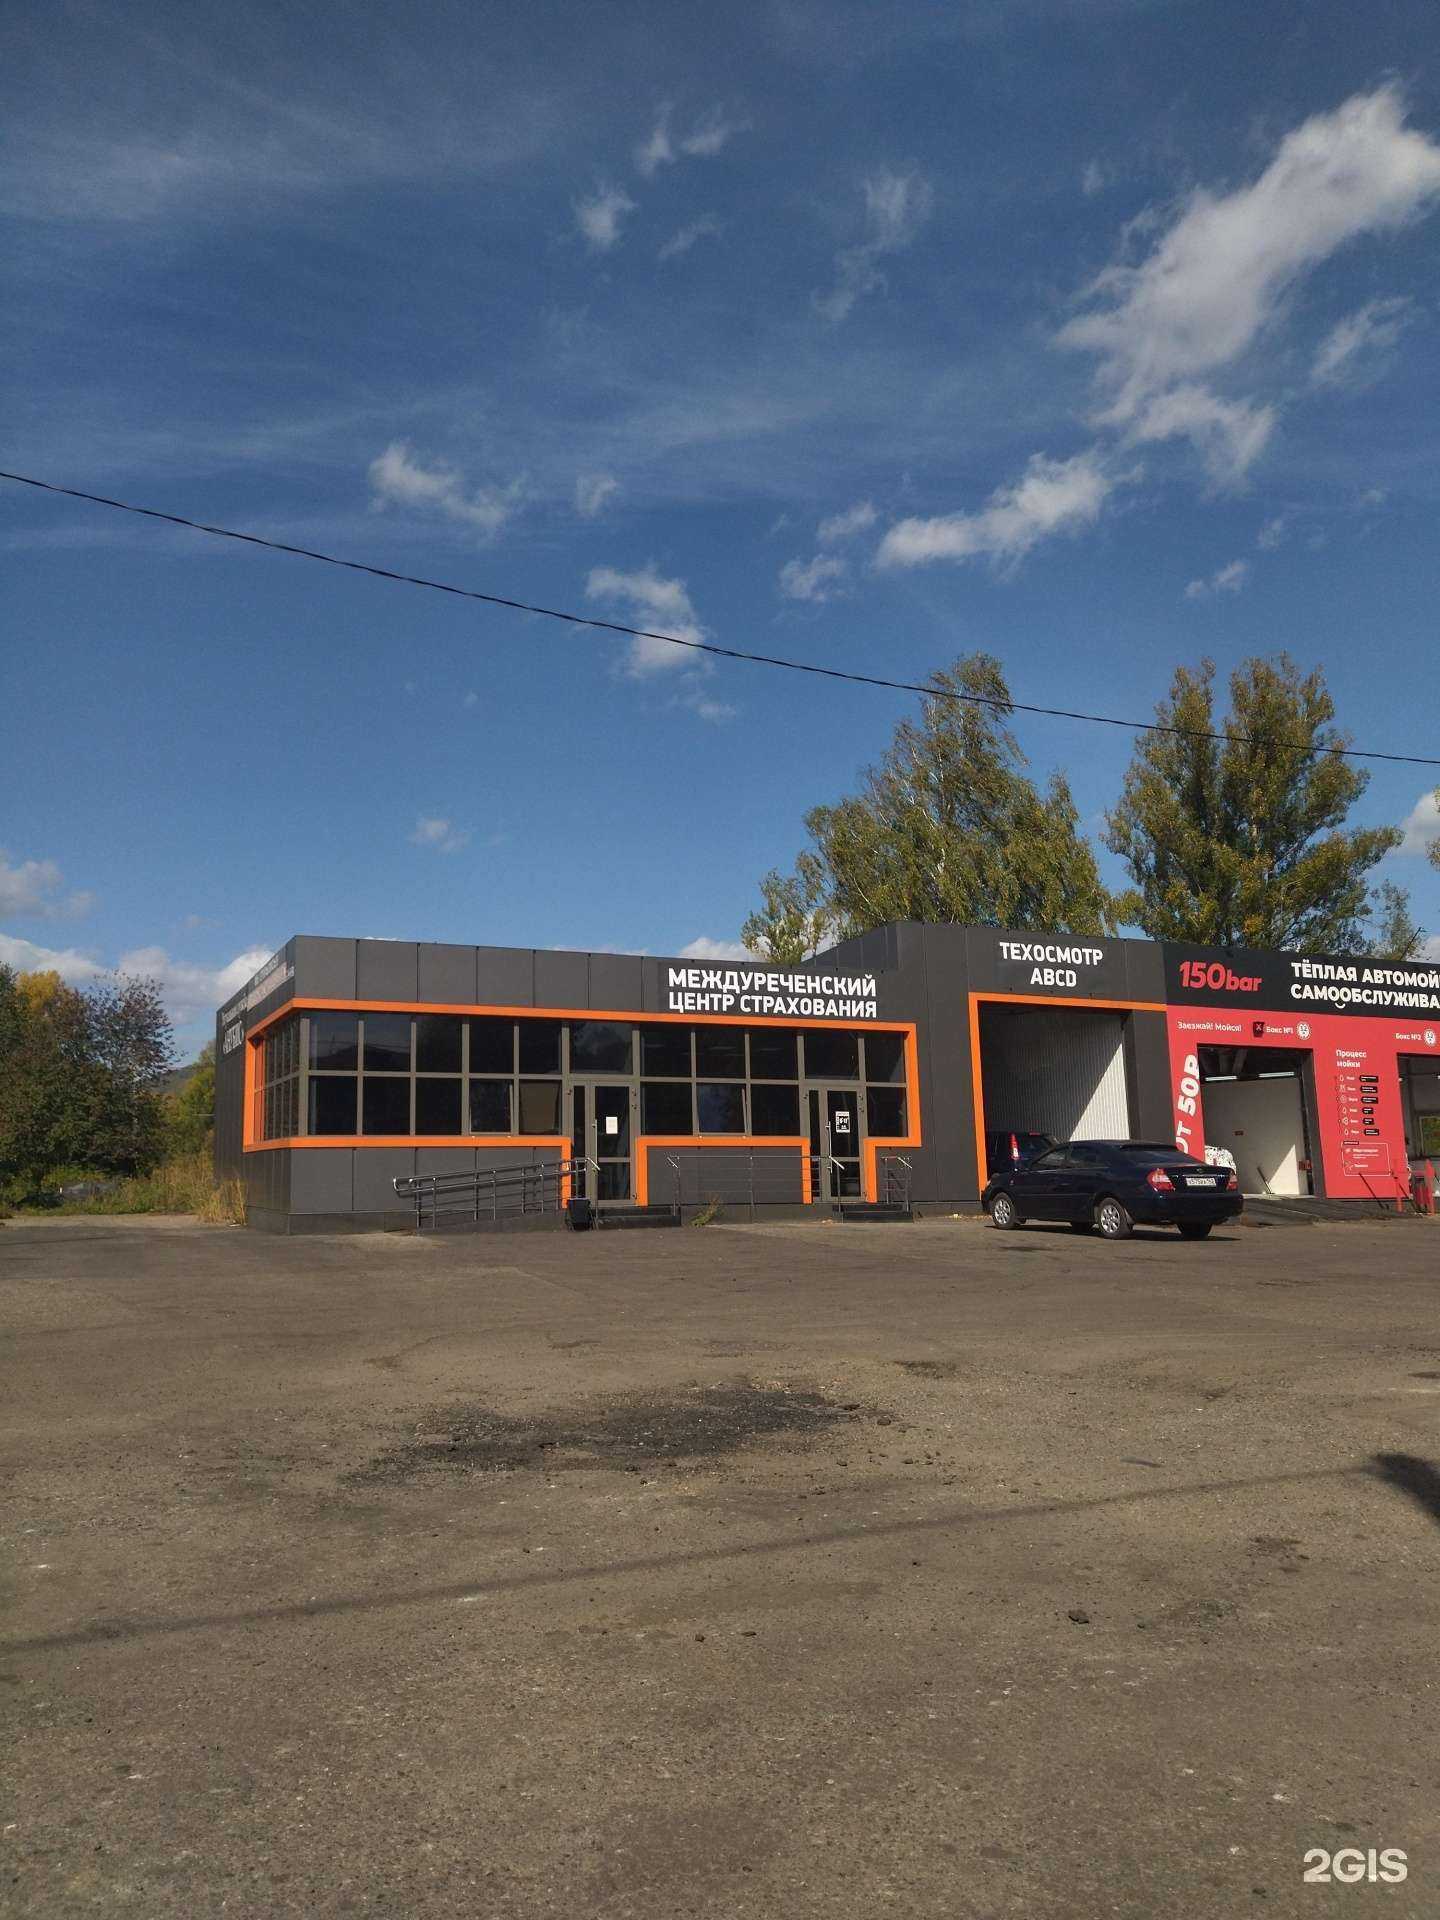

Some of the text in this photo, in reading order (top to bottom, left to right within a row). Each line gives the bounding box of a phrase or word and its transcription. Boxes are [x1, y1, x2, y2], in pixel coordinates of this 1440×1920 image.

[999, 941, 1104, 966] ТЕХОСМОТР
[668, 967, 877, 997] МЕЖДУРЕЧЕНСКИЙ
[1030, 967, 1077, 987] ABCD
[1179, 960, 1263, 992] 150bar
[1290, 958, 1440, 989] ТЁПЛАЯ АВТОМОЙ
[668, 991, 877, 1018] ЦЕНТР СТРАХОВАНИЯ
